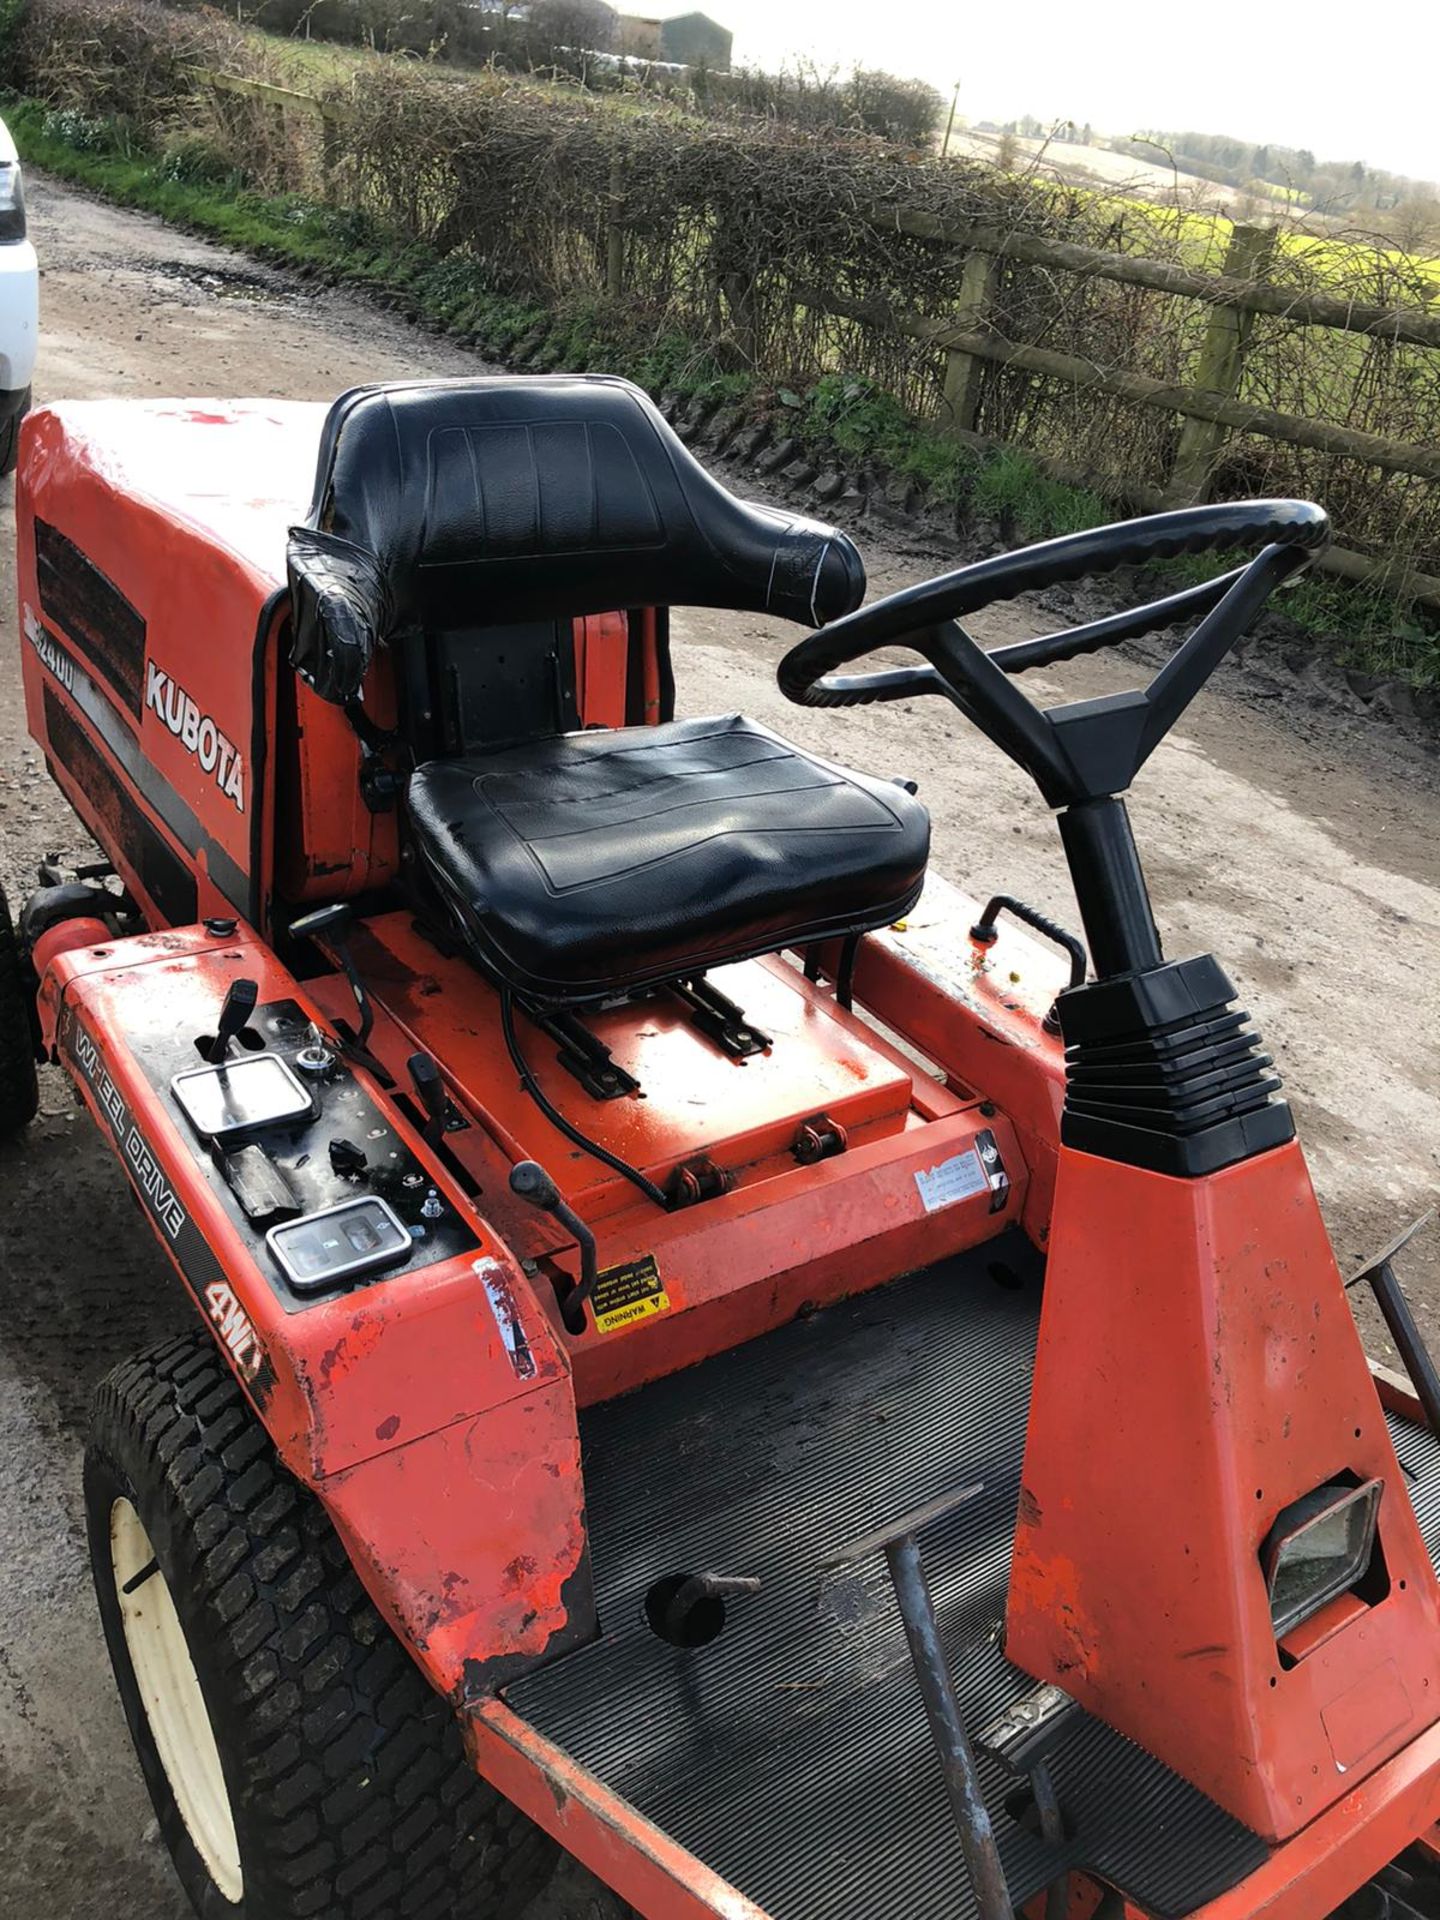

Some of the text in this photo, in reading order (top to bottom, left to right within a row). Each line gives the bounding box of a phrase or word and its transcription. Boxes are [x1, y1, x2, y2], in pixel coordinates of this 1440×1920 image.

[146, 658, 245, 812] KUBOTA
[126, 1127, 185, 1239] DRIVE
[605, 1305, 645, 1326] WARNING
